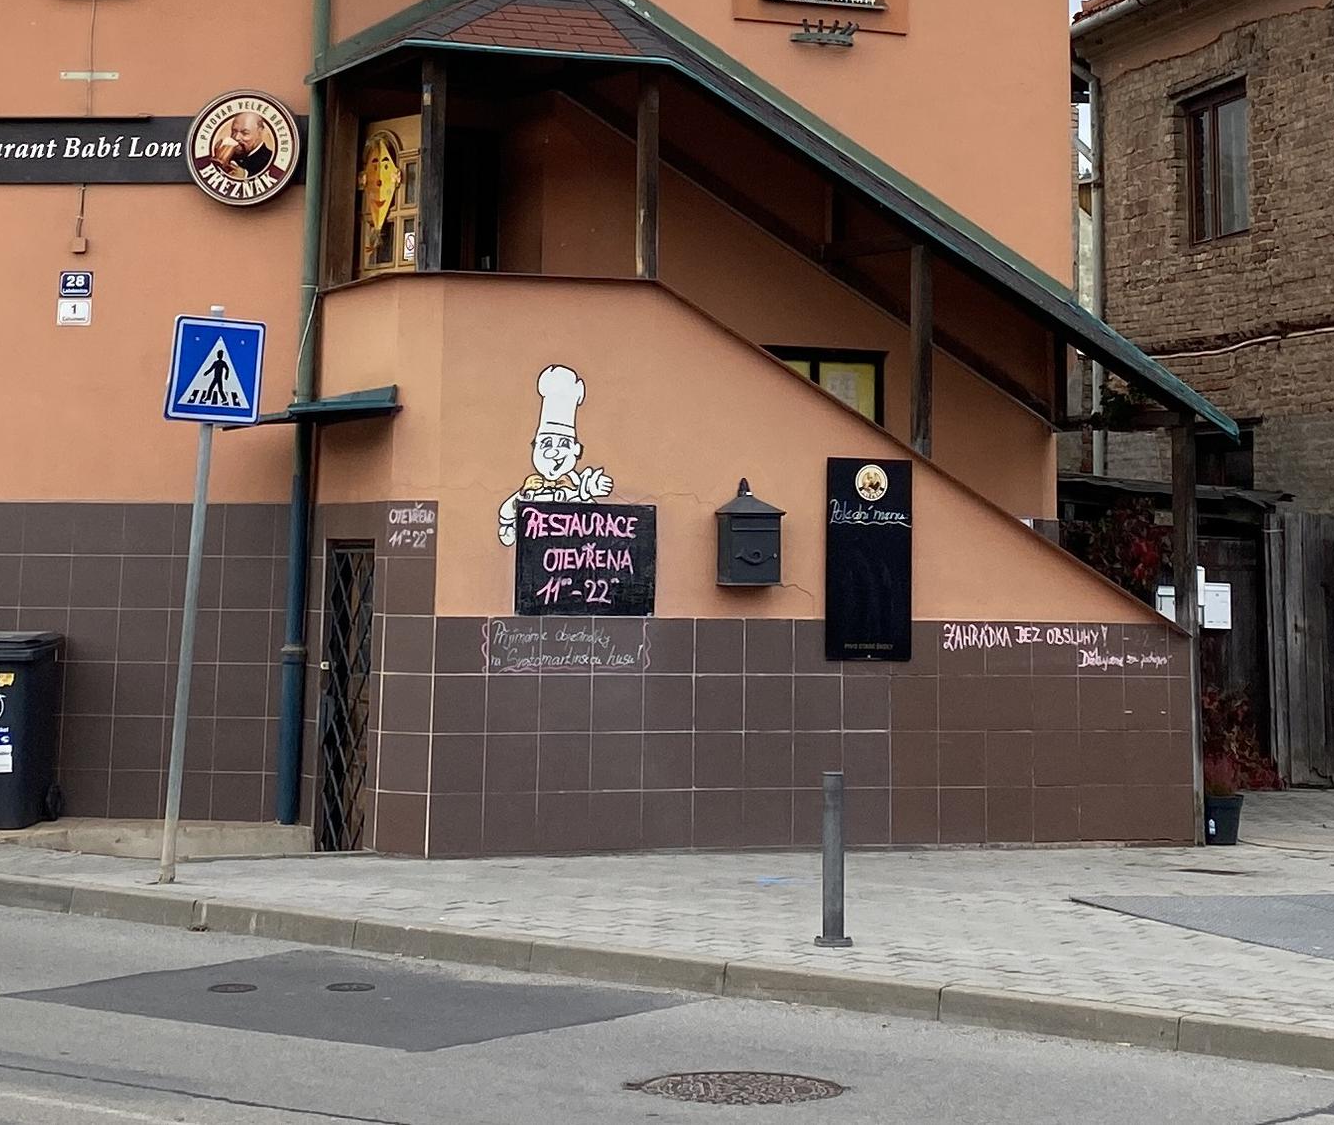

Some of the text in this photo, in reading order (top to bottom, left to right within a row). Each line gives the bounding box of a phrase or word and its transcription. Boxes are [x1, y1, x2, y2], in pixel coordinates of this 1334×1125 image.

[63, 135, 125, 159] Babí
[128, 137, 182, 158] Lom
[66, 275, 86, 287] 28
[71, 304, 77, 314] 1
[522, 507, 638, 539] RESTAURACE
[543, 542, 634, 575] OTEVŘENA
